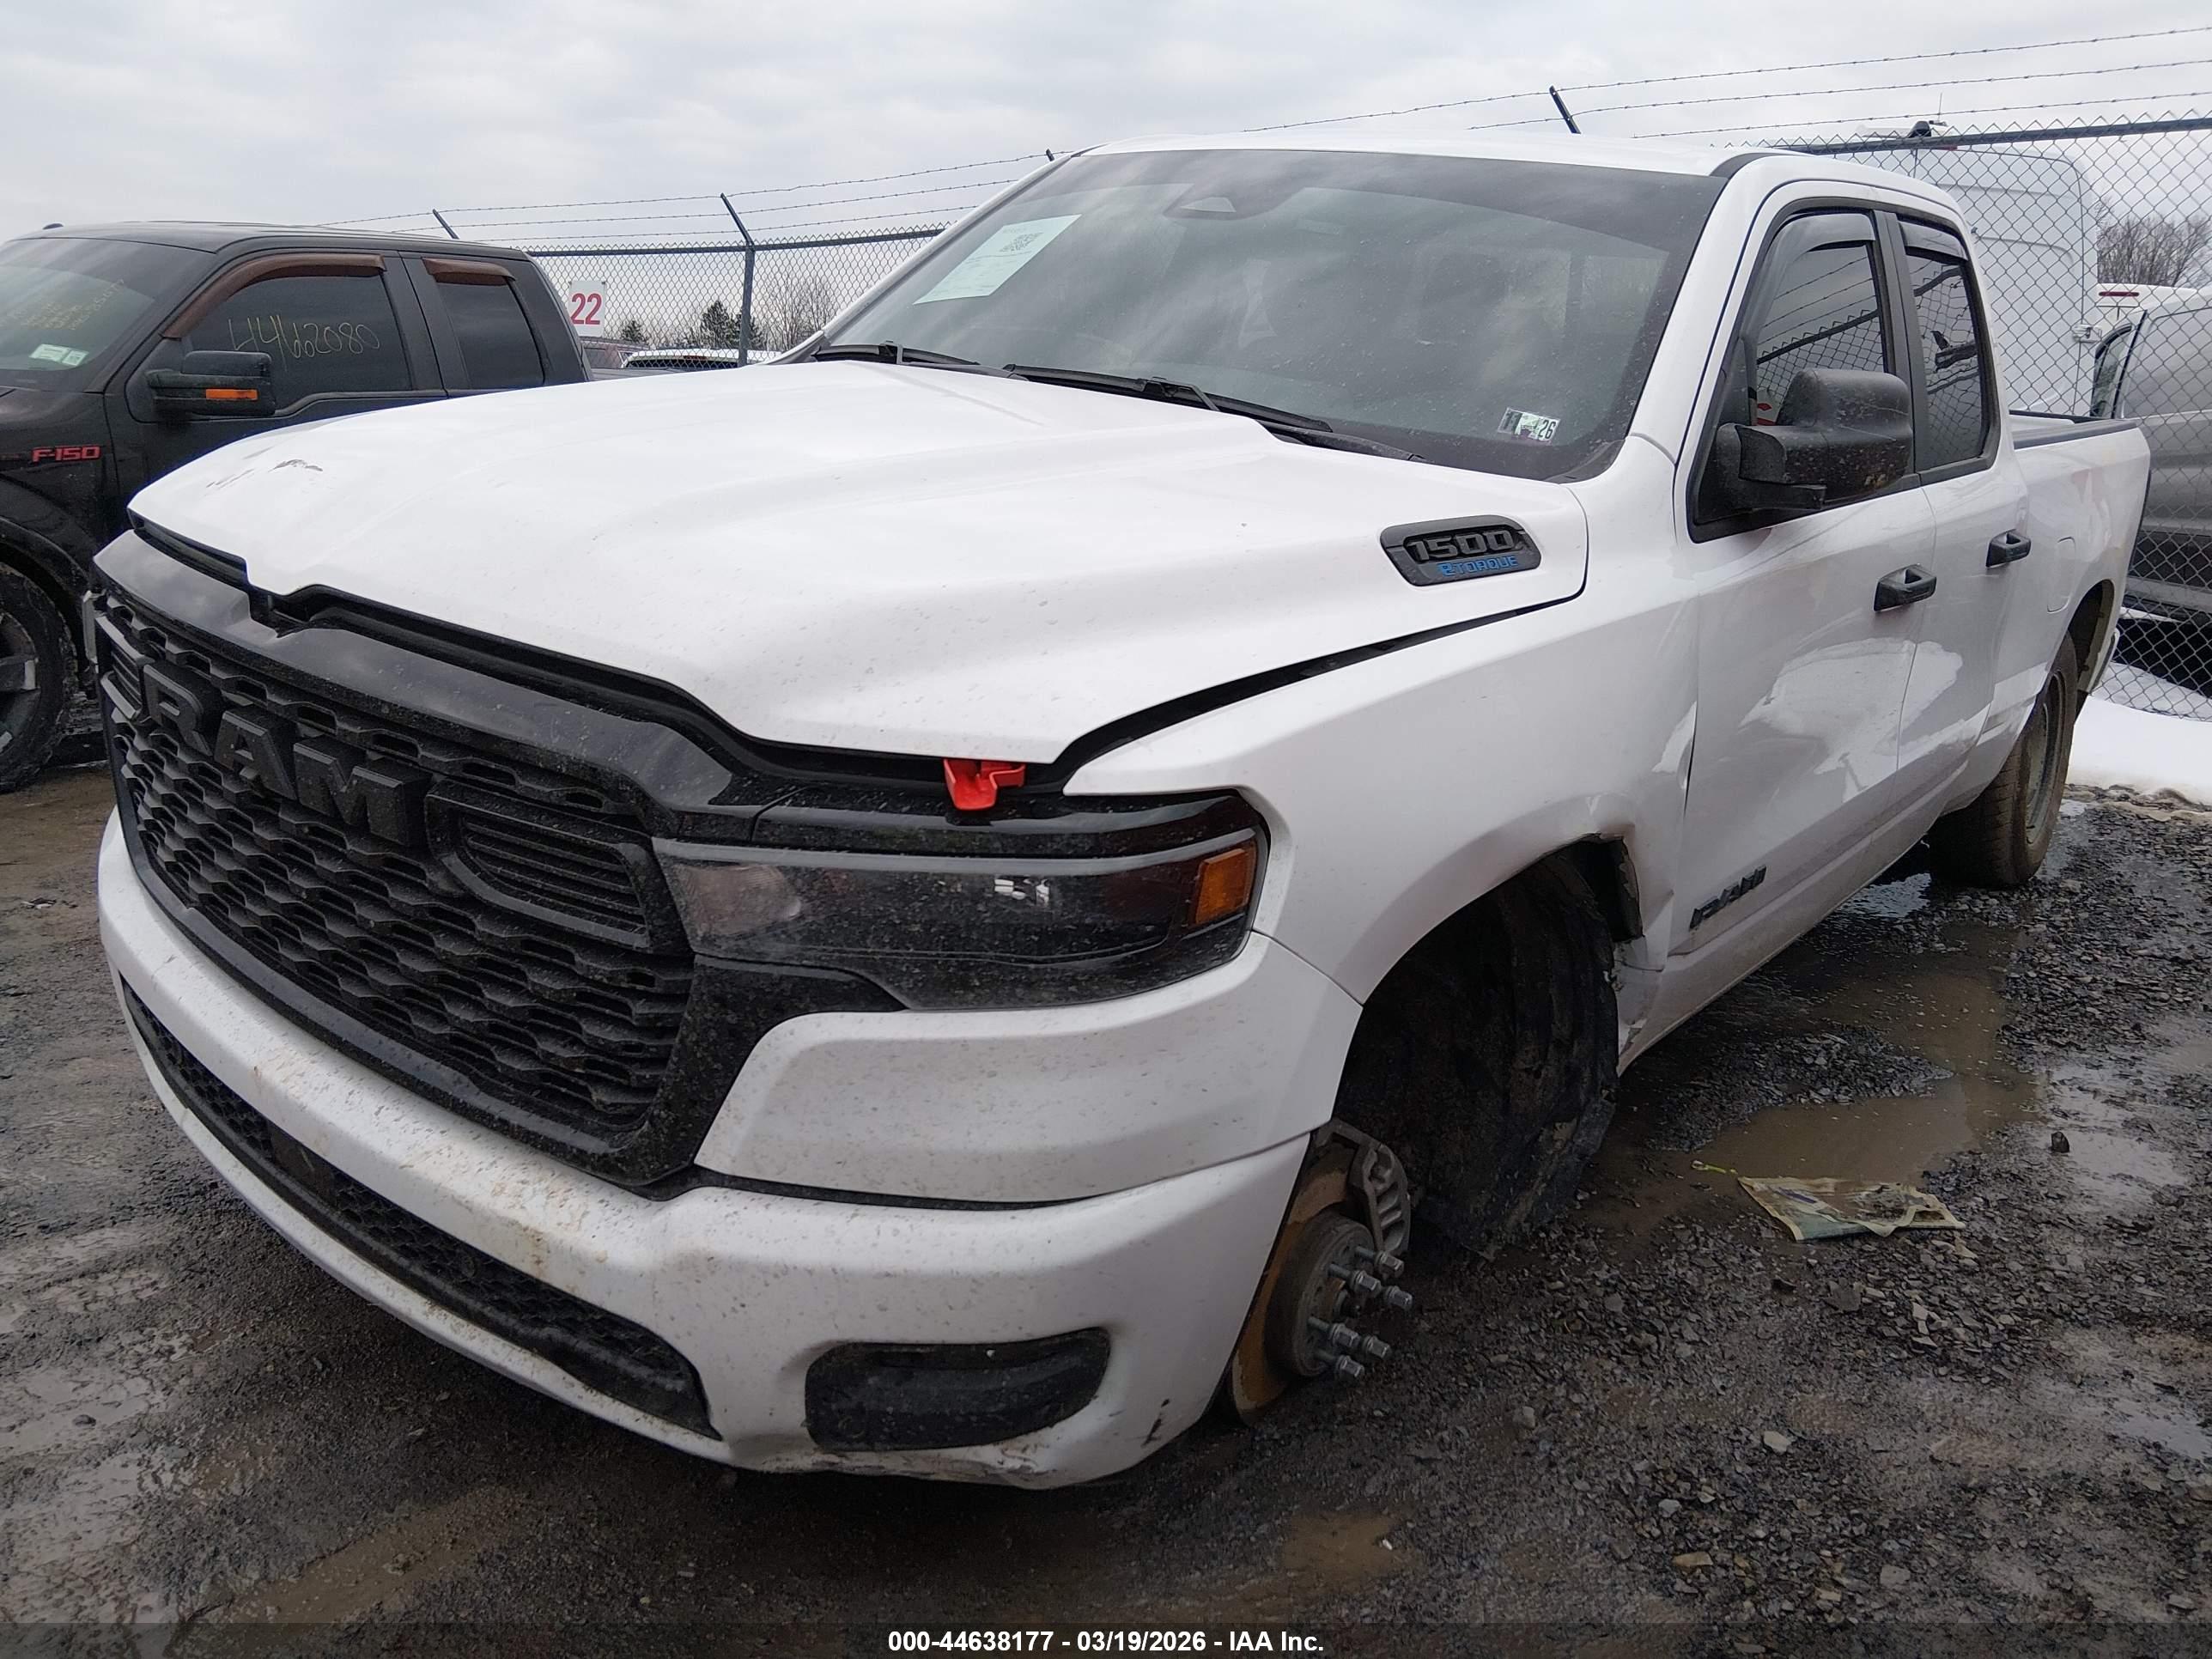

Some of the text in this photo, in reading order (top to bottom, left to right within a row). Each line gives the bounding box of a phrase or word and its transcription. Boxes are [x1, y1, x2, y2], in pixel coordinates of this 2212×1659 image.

[571, 293, 602, 325] 22
[1538, 419, 1557, 440] 26
[32, 445, 102, 465] F-150
[1407, 529, 1516, 562] 1500
[143, 659, 434, 846] RAM
[1689, 864, 1767, 930] RAM
